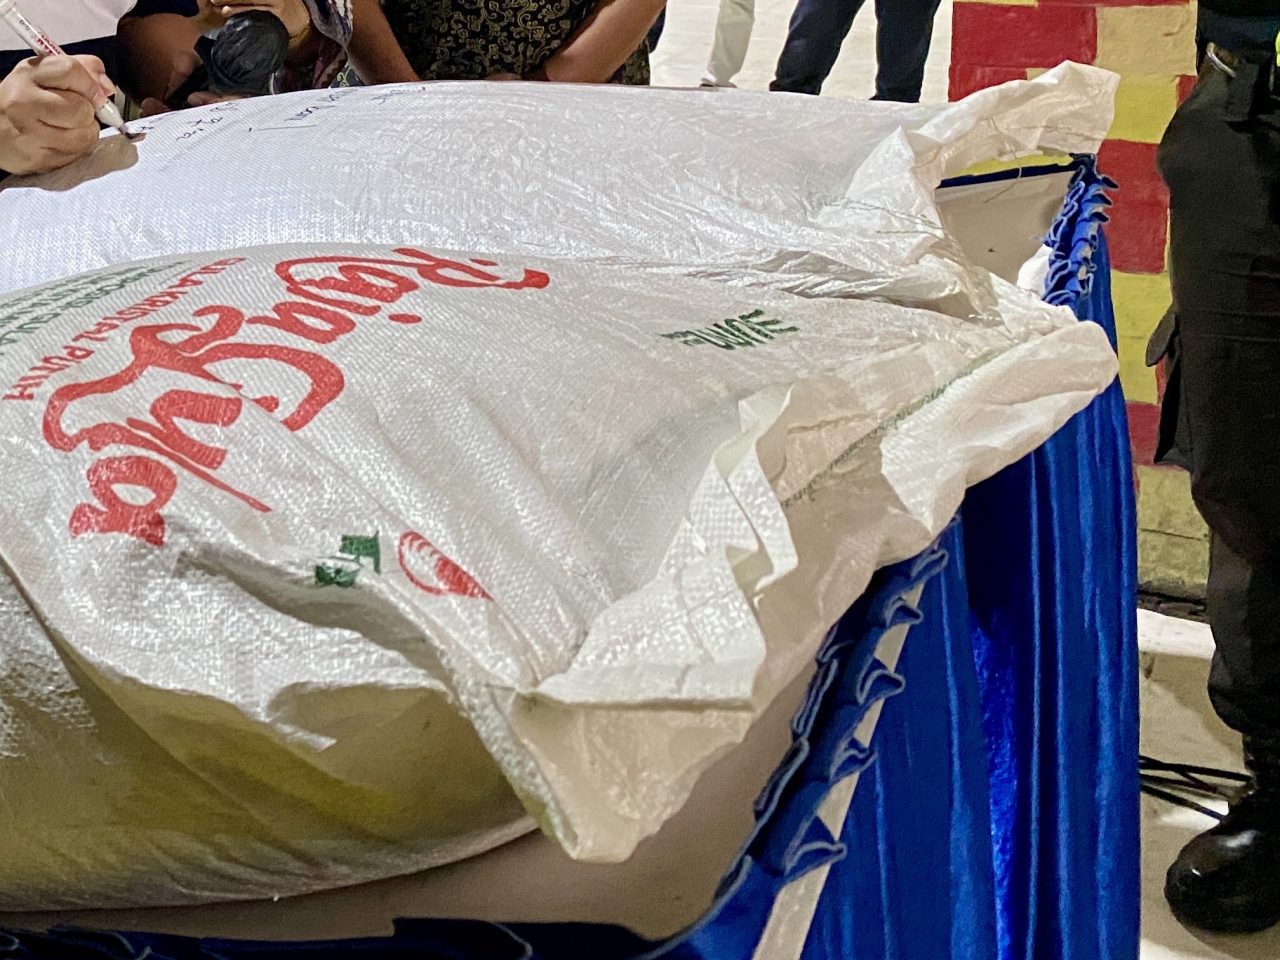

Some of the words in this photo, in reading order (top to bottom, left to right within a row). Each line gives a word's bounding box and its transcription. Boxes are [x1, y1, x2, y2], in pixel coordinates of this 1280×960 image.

[167, 256, 247, 289] GULA
[245, 247, 550, 344] Raja
[73, 290, 188, 342] KRISTAL
[2, 344, 94, 401] PUTIH
[42, 305, 344, 546] Gula
